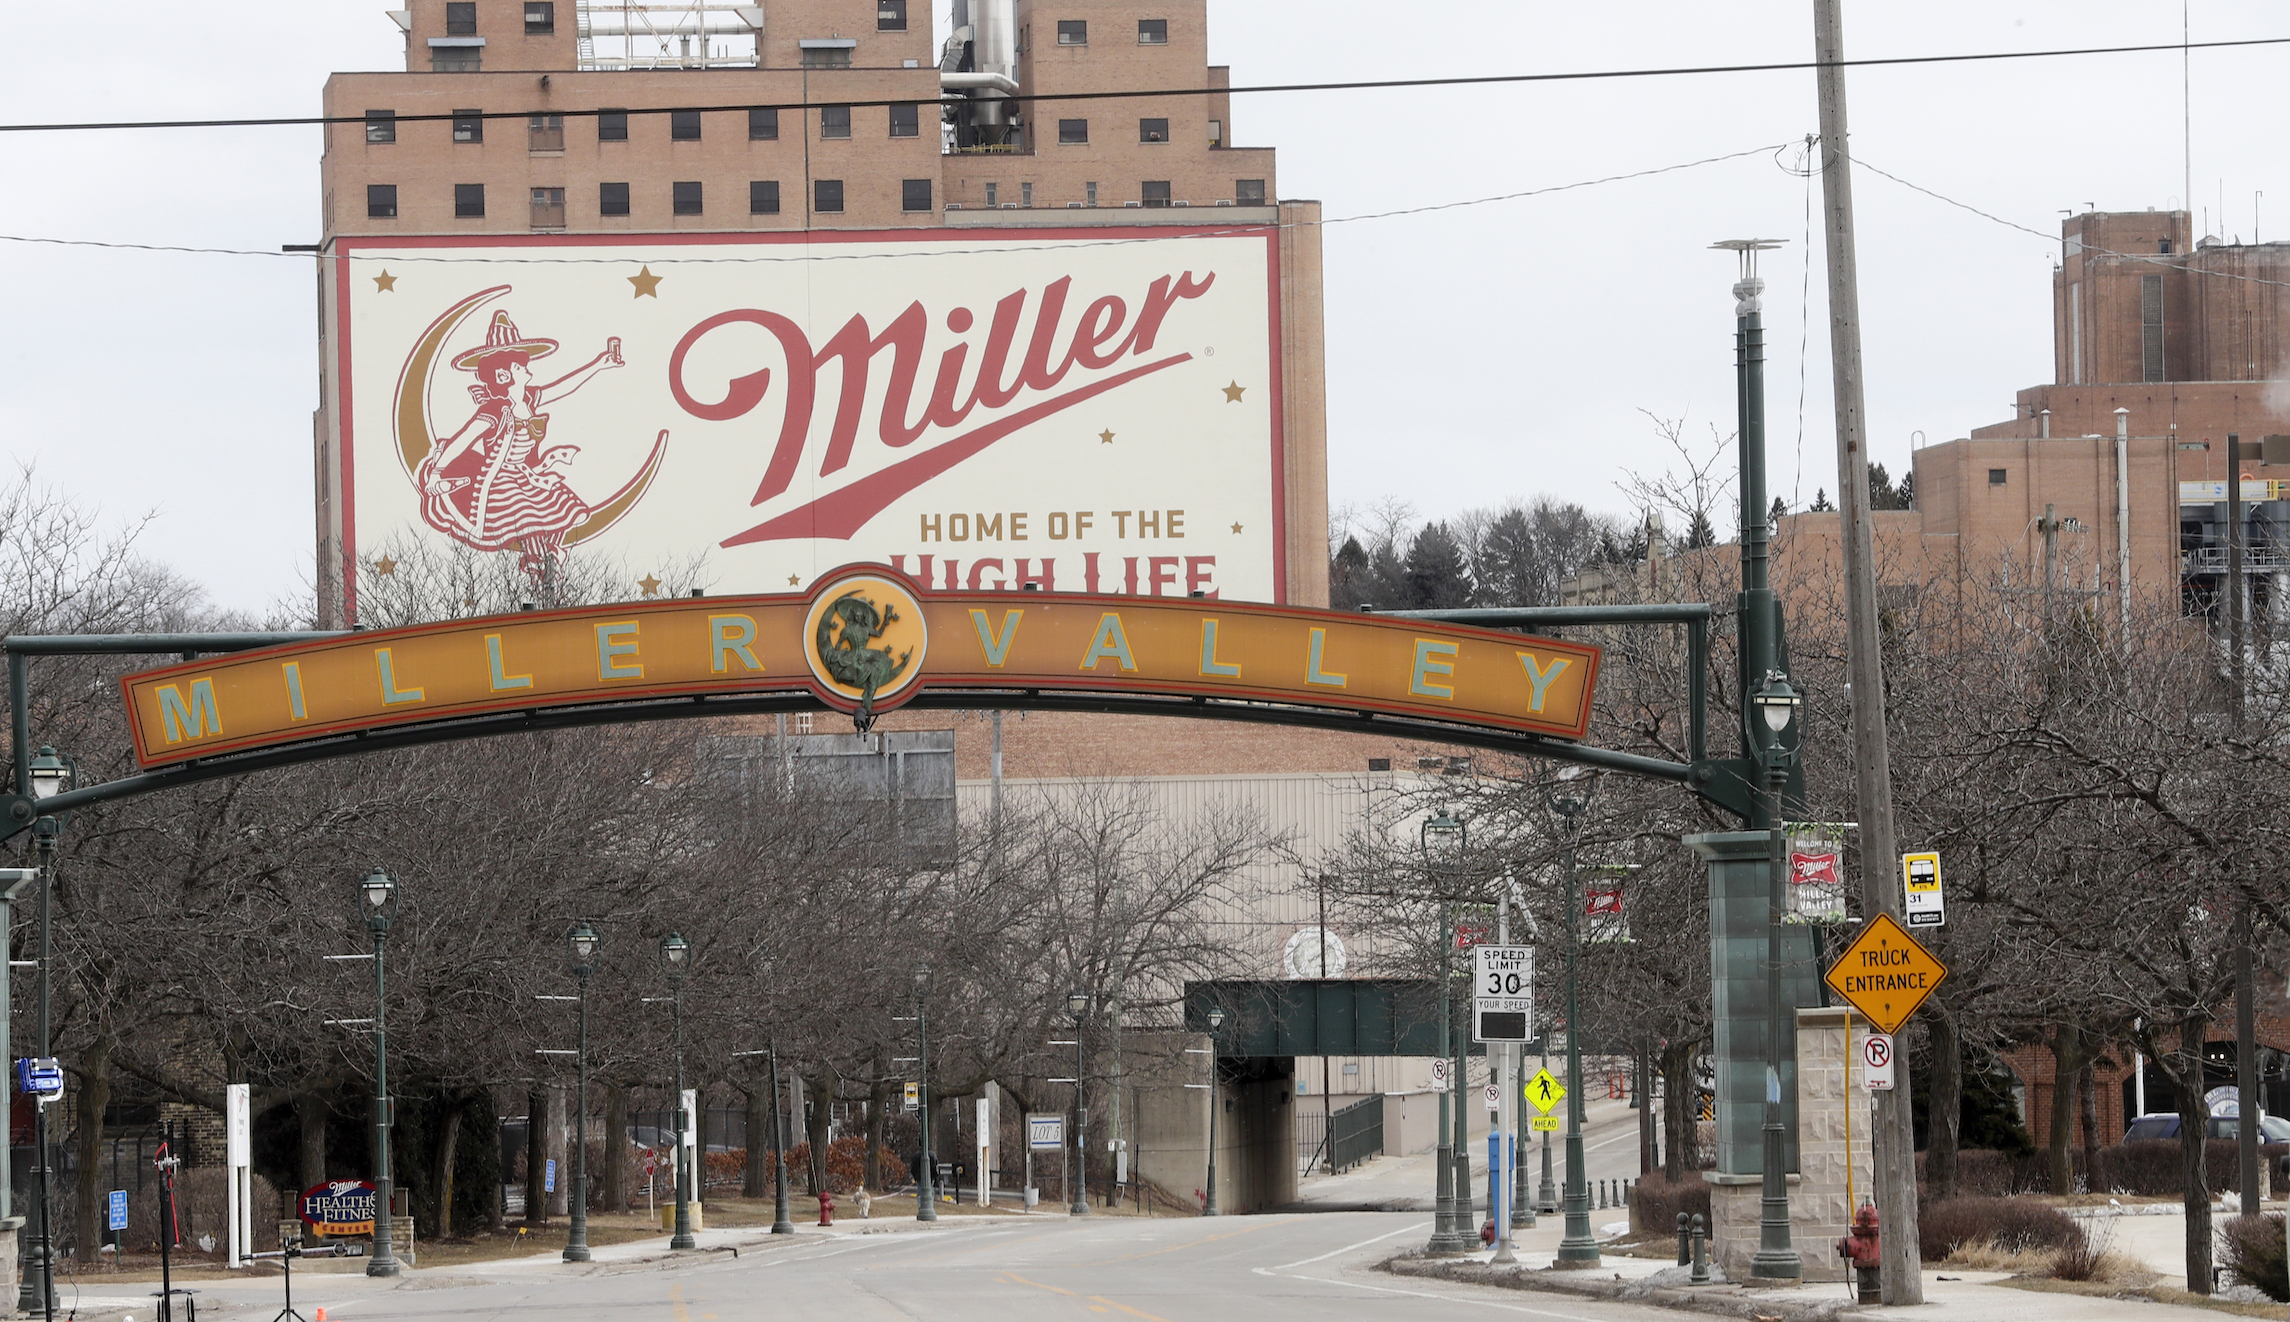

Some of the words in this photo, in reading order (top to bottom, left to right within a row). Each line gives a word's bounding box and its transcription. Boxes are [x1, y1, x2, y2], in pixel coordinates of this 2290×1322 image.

[669, 270, 1216, 508] Miller
[920, 512, 1028, 542] HOME
[1048, 511, 1094, 540] OF
[1111, 509, 1185, 539] THE
[889, 553, 1057, 593] HIGH
[1083, 552, 1220, 600] LIFE
[155, 612, 767, 745] MILLER
[968, 608, 1573, 714] VALLEY
[1824, 840, 1833, 849] TO
[1797, 860, 1831, 876] Miller
[1800, 900, 1833, 910] VALLEY
[1910, 894, 1922, 904] 31
[1484, 950, 1525, 960] SPEED
[1860, 949, 1911, 967] TRUCK
[1488, 961, 1521, 970] LIMIT
[1487, 973, 1521, 994] 30
[1846, 972, 1928, 993] ENTRANCE
[1478, 1000, 1500, 1009] YOUR
[1504, 1000, 1530, 1009] SPEED
[1534, 1119, 1557, 1128] AHEAD
[1033, 1126, 1051, 1140] LOT
[1054, 1126, 1060, 1139] 5
[329, 1180, 363, 1195] Miller
[305, 1196, 370, 1214] HEALTH
[323, 1208, 376, 1225] FITNES
